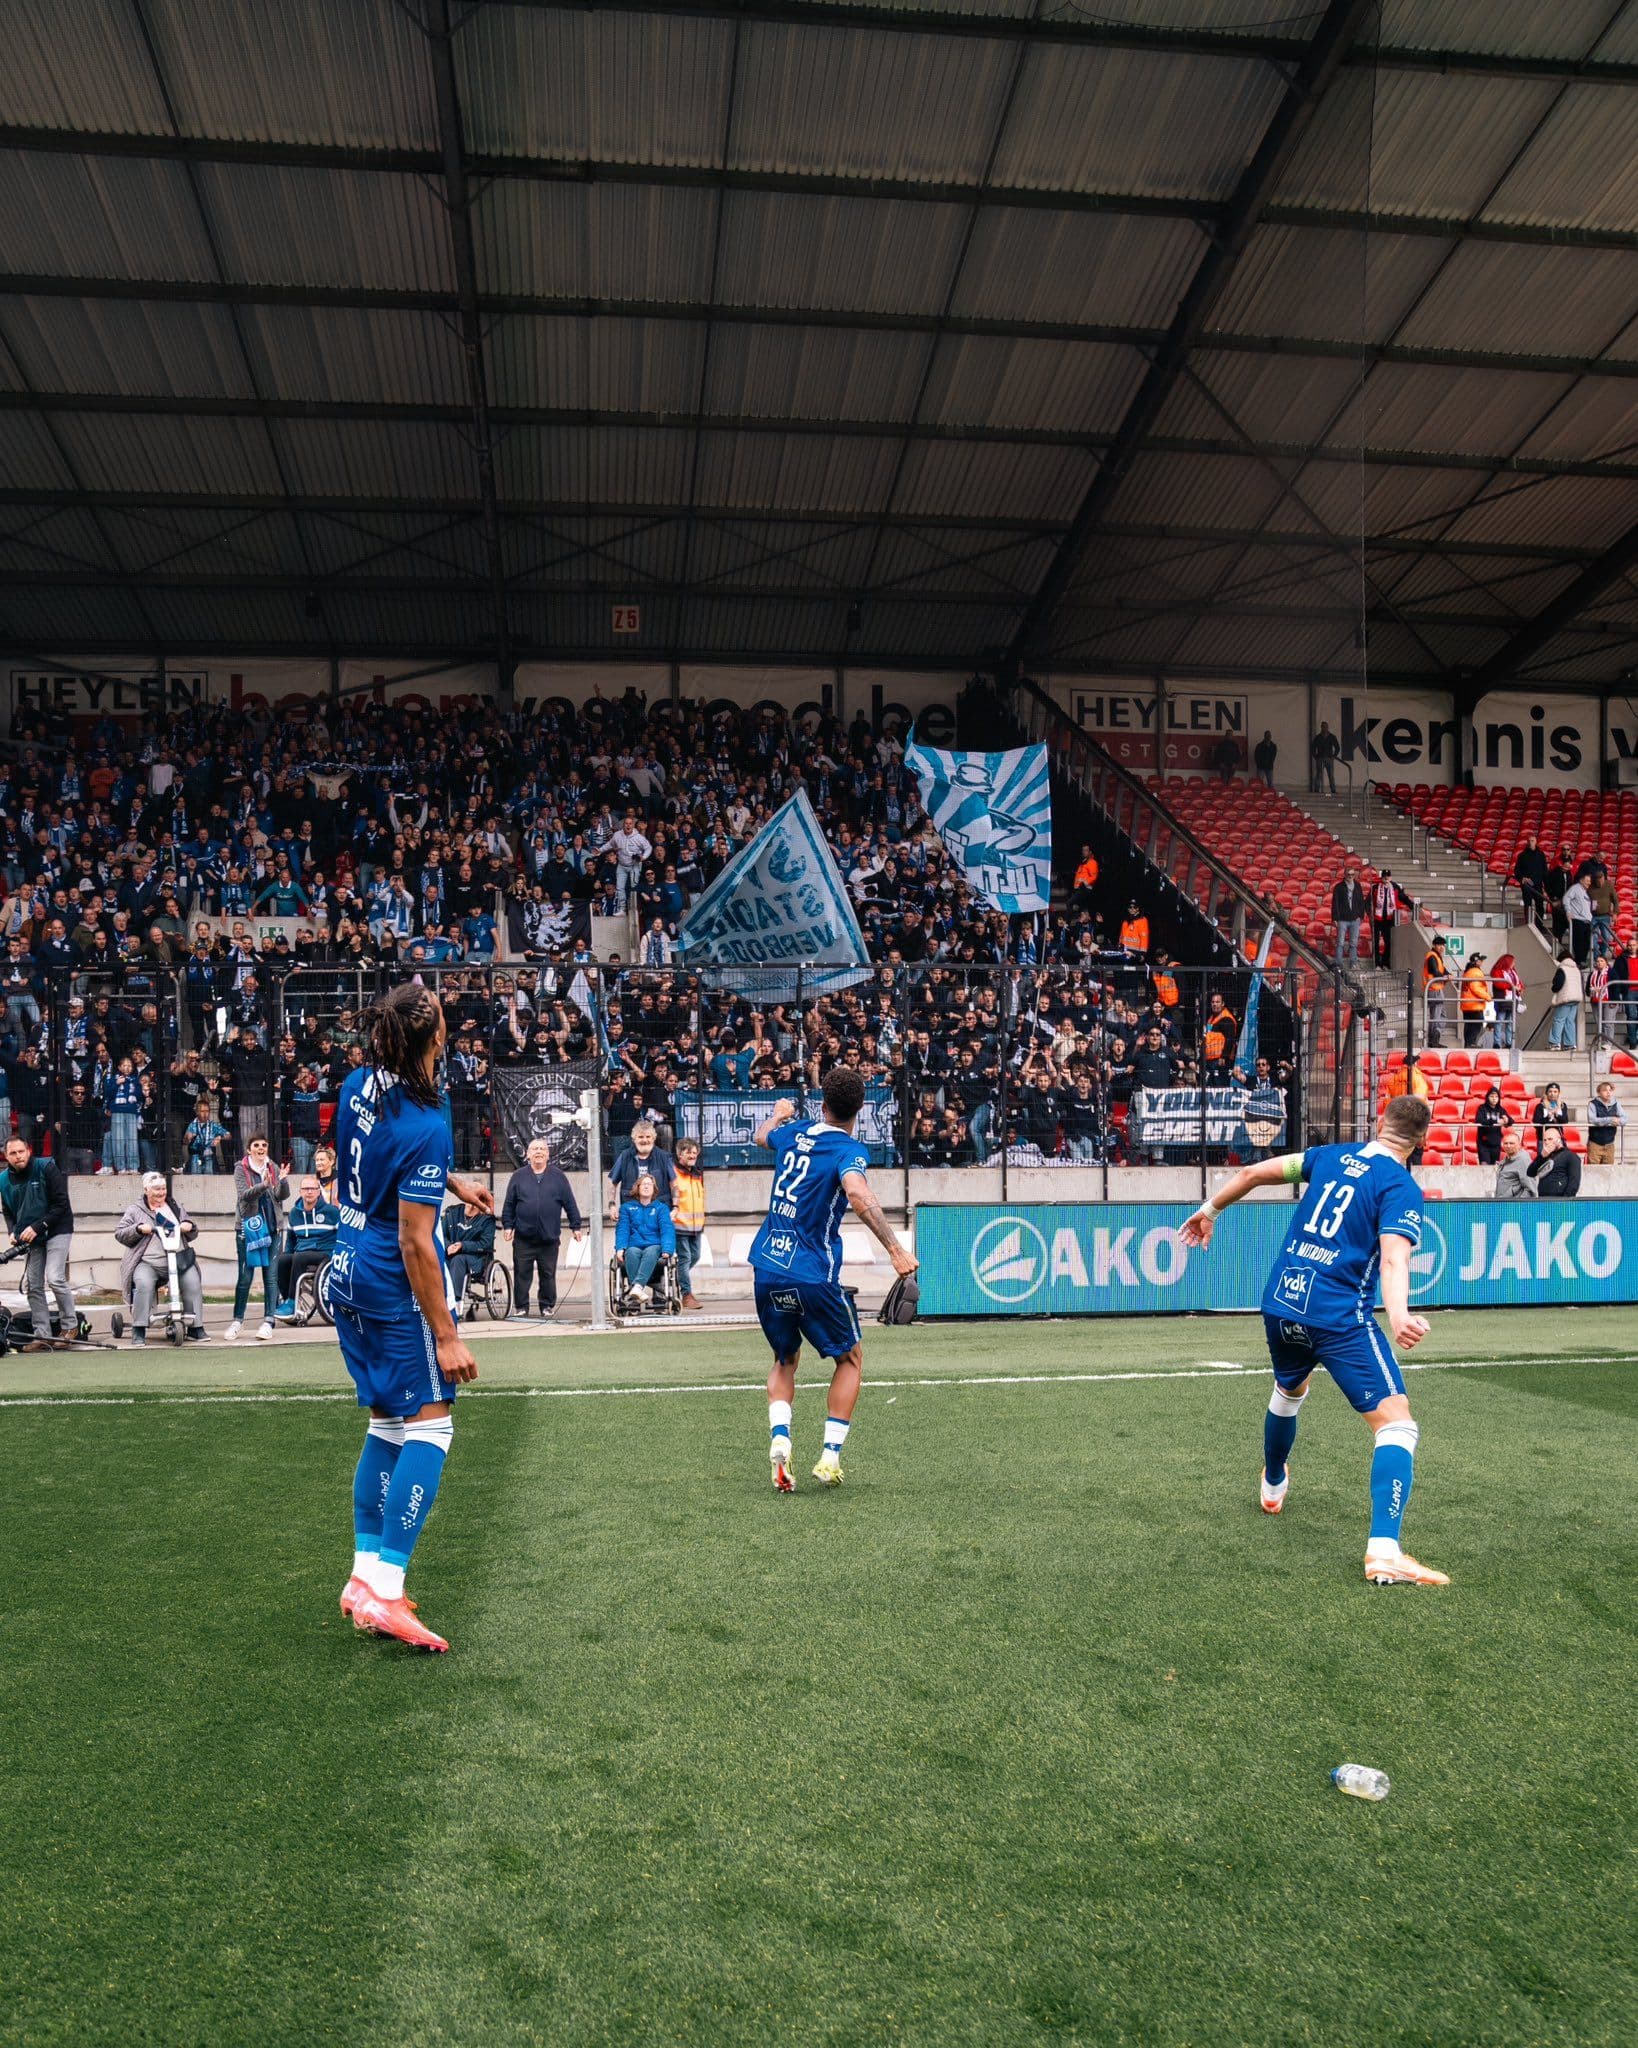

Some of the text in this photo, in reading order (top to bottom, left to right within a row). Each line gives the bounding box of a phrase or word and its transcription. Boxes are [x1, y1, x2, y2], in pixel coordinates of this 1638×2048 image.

[17, 677, 201, 710] HEYLEN
[1076, 695, 1242, 732] HEYLEN
[1340, 697, 1582, 772] kennis
[525, 1072, 577, 1089] GHENT
[349, 1095, 377, 1125] Circus
[1144, 1091, 1245, 1113] YOUNG
[348, 1137, 362, 1204] 3
[773, 1151, 811, 1203] 22
[1339, 1153, 1371, 1173] Circus
[1302, 1180, 1355, 1239] 13
[770, 1234, 794, 1252] vdk
[1050, 1227, 1189, 1288] AKO
[1459, 1220, 1623, 1282] JAKO
[1283, 1273, 1307, 1293] vdk
[405, 1484, 425, 1520] CRAFT
[1389, 1478, 1404, 1511] CRAFT
